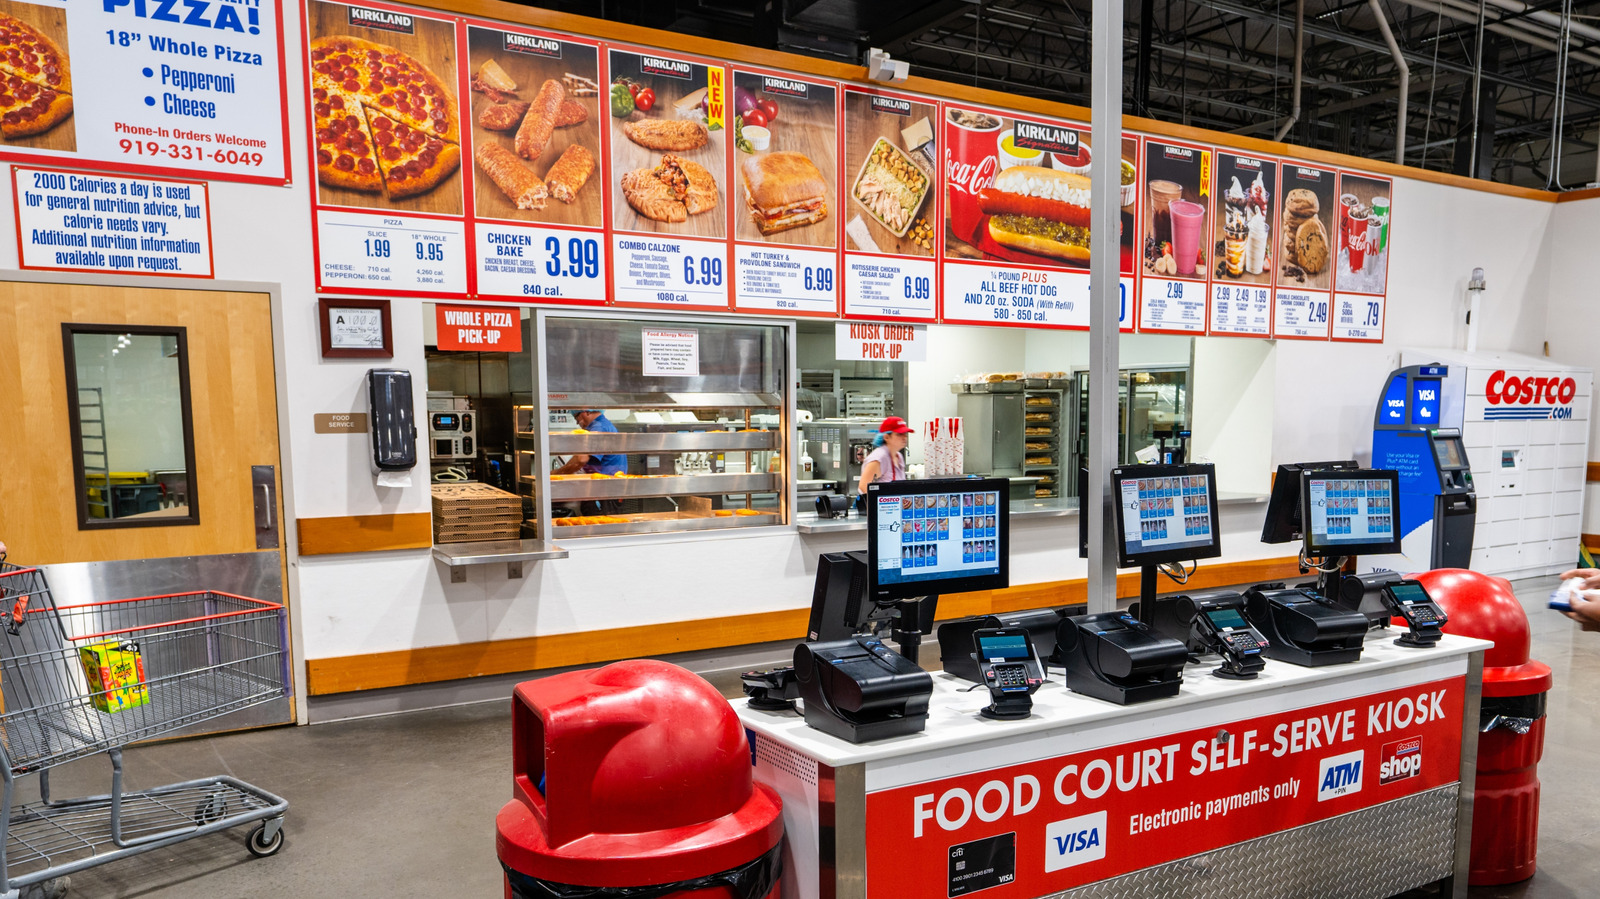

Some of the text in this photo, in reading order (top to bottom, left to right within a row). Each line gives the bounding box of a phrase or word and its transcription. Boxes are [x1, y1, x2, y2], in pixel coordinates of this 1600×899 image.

[352, 8, 412, 27] KIRKLAND
[149, 35, 208, 58] Whole
[215, 40, 262, 66] Pizza
[506, 34, 559, 51] KIRKLAND
[644, 57, 690, 73] KIRKLAND
[161, 64, 235, 94] Pepperoni
[765, 77, 806, 92] KIRKLAND
[710, 71, 724, 119] NEW
[872, 97, 910, 110] KIRKLAND
[164, 92, 216, 119] Cheese
[114, 122, 267, 148] Phone-In Orders Welcome
[1017, 123, 1077, 145] KIRKLAND
[119, 138, 263, 166] 919-331-6049
[1017, 136, 1076, 152] Signature
[1166, 146, 1192, 157] KIRKLAND
[1237, 157, 1261, 168] KIRKLAND
[1298, 168, 1320, 177] KIRKLAND
[34, 173, 190, 200] 2000 Calories a day is used
[26, 191, 200, 220] for general nutrition advice, but
[63, 214, 169, 236] calorie needs vary.
[32, 230, 200, 254] Additional nutrition information
[488, 233, 531, 246] CHICKEN
[619, 241, 680, 253] COMBO CALZONE
[364, 239, 443, 261] 1.99 9.95
[497, 246, 523, 257] BAKE
[545, 236, 599, 278] 3.99
[56, 252, 182, 272] available upon request.
[740, 258, 771, 267] PROVOLONE
[684, 256, 722, 286] 6.99
[804, 267, 832, 292] 6.99
[998, 272, 1020, 281] POUND
[1022, 272, 1048, 283] PLUS
[523, 284, 562, 296] 840 cal.
[904, 276, 929, 299] 6.99
[981, 281, 1057, 296] ALL BEEF HOT DOG
[1167, 282, 1183, 299] 2.99
[1217, 287, 1266, 303] 2.99 2.49 1.99
[657, 293, 689, 302] 1080 cal.
[964, 293, 1074, 311] AND 20 oz. SODA (With Refill)
[336, 315, 345, 324] A
[445, 311, 512, 327] WHOLE PIZZA
[994, 309, 1009, 319] 580
[1017, 310, 1031, 320] 850
[1034, 311, 1048, 321] cal.
[1309, 302, 1327, 322] 2.49
[1363, 302, 1379, 326] .79
[458, 329, 501, 344] PICK-UP
[850, 323, 914, 341] KIOSK ORDER
[862, 343, 902, 359] PICK-UP
[1418, 390, 1435, 401] VISA
[1485, 370, 1576, 405] COSTCO
[1388, 399, 1404, 408] VISA
[1550, 407, 1572, 419] .COM
[914, 689, 1447, 838] FOOD COURT SELF-SERVE KIOSK
[1380, 754, 1421, 779] shop
[1320, 760, 1361, 792] ATM
[1129, 777, 1300, 835] Electronic payments only
[1054, 827, 1100, 856] VISA
[952, 848, 964, 858] citi
[999, 874, 1013, 883] VISA
